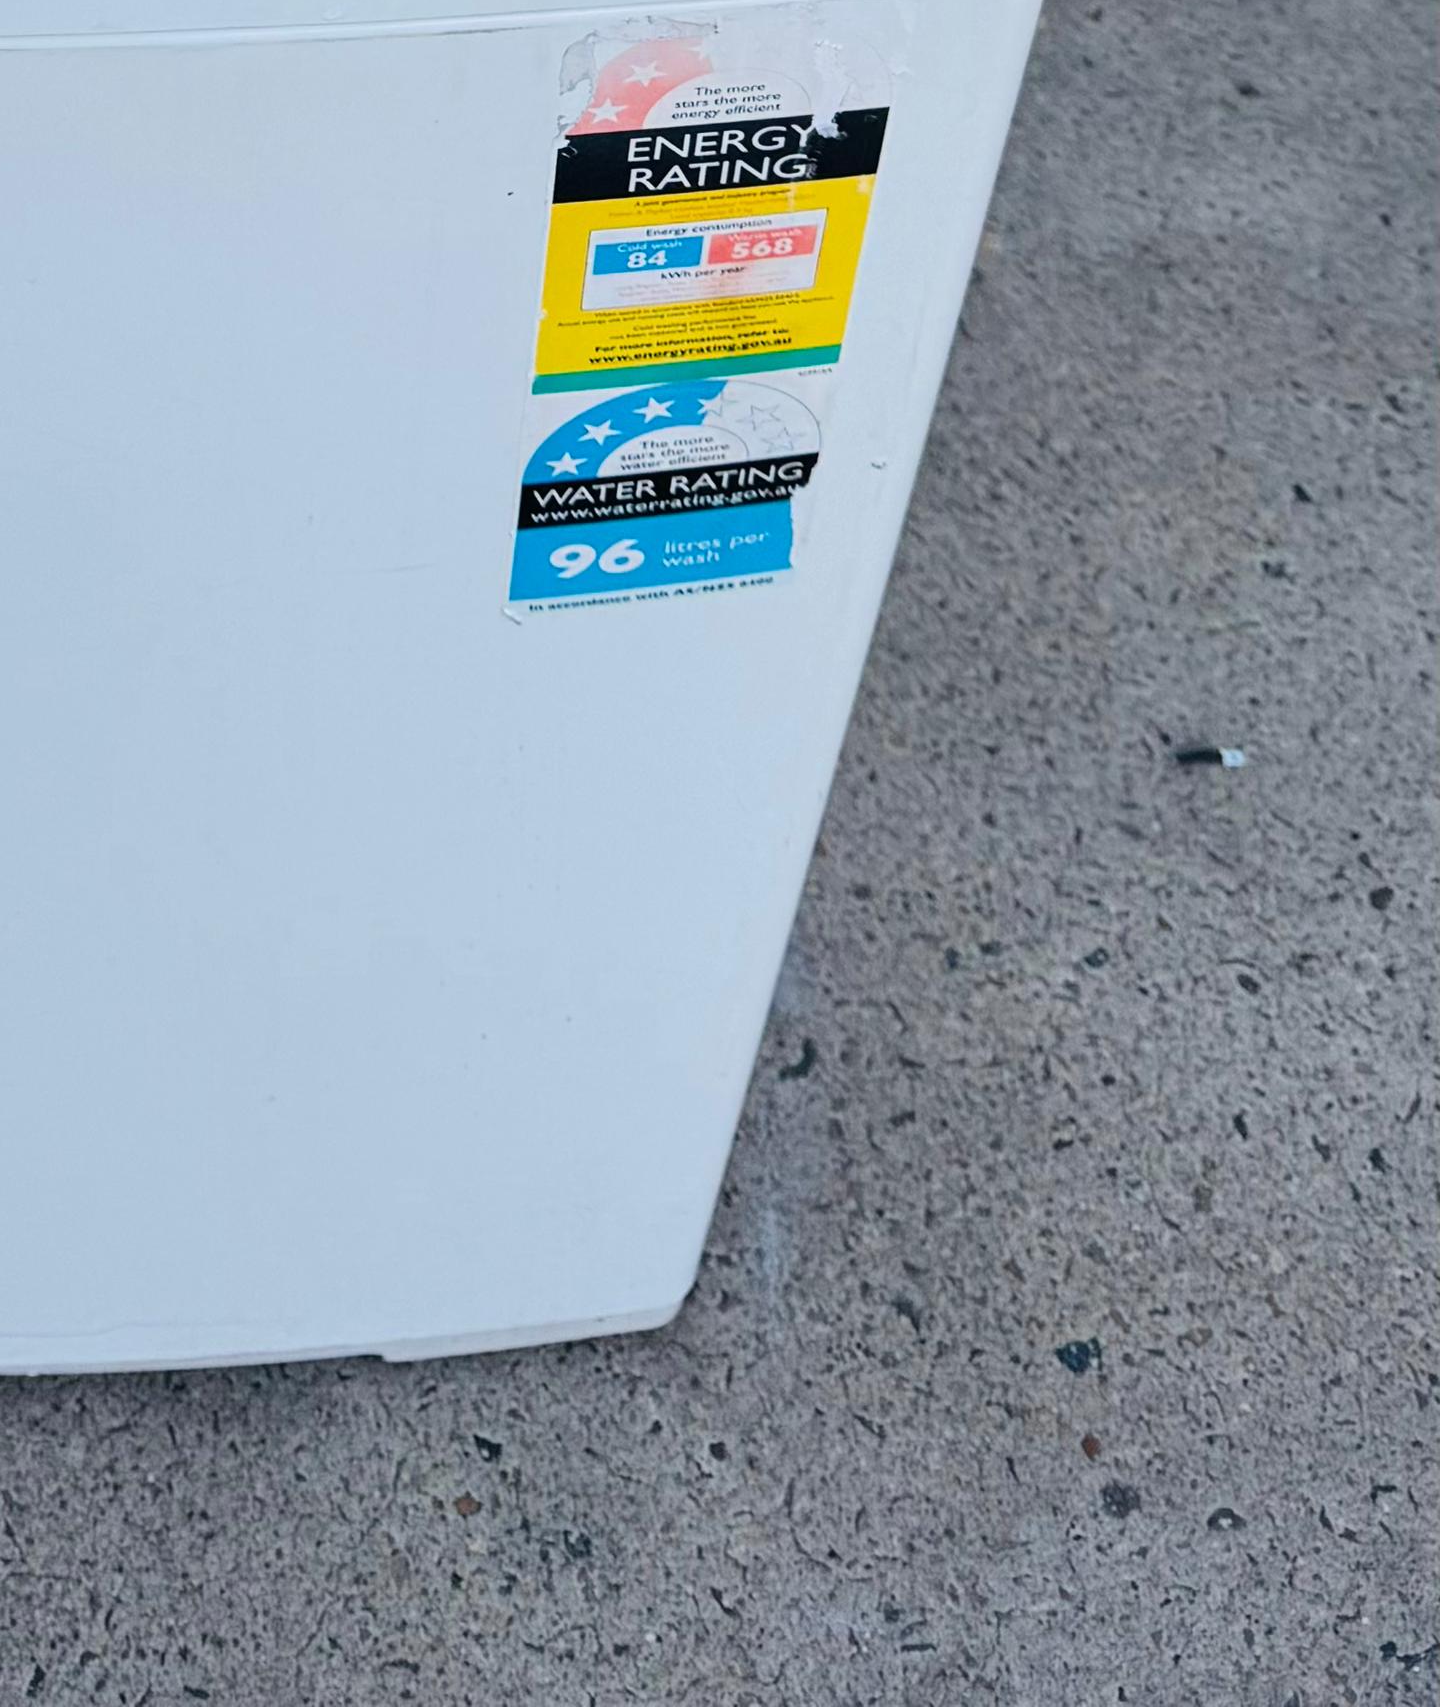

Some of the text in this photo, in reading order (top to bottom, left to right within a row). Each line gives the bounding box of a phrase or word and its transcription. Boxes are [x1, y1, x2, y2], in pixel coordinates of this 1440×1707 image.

[694, 81, 766, 96] The more
[674, 92, 782, 109] stars the more
[671, 102, 781, 121] energy efficient
[627, 124, 814, 162] ENERGY
[627, 154, 809, 192] RATING
[647, 219, 773, 237] Energy consumption
[618, 239, 683, 252] Cold wash
[731, 238, 793, 259] 568
[627, 250, 667, 269] 84
[661, 265, 745, 280] kWh per year
[595, 344, 615, 353] For
[656, 333, 733, 347] information,
[738, 329, 767, 337] refer
[589, 337, 793, 365] www.energyrating.gov.au
[621, 443, 730, 460] stars the more
[640, 436, 713, 448] The more
[621, 453, 725, 469] water efficient
[532, 461, 805, 508] WATER RATING
[665, 531, 769, 553] litres per
[549, 538, 645, 579] 96
[662, 550, 720, 567] wash
